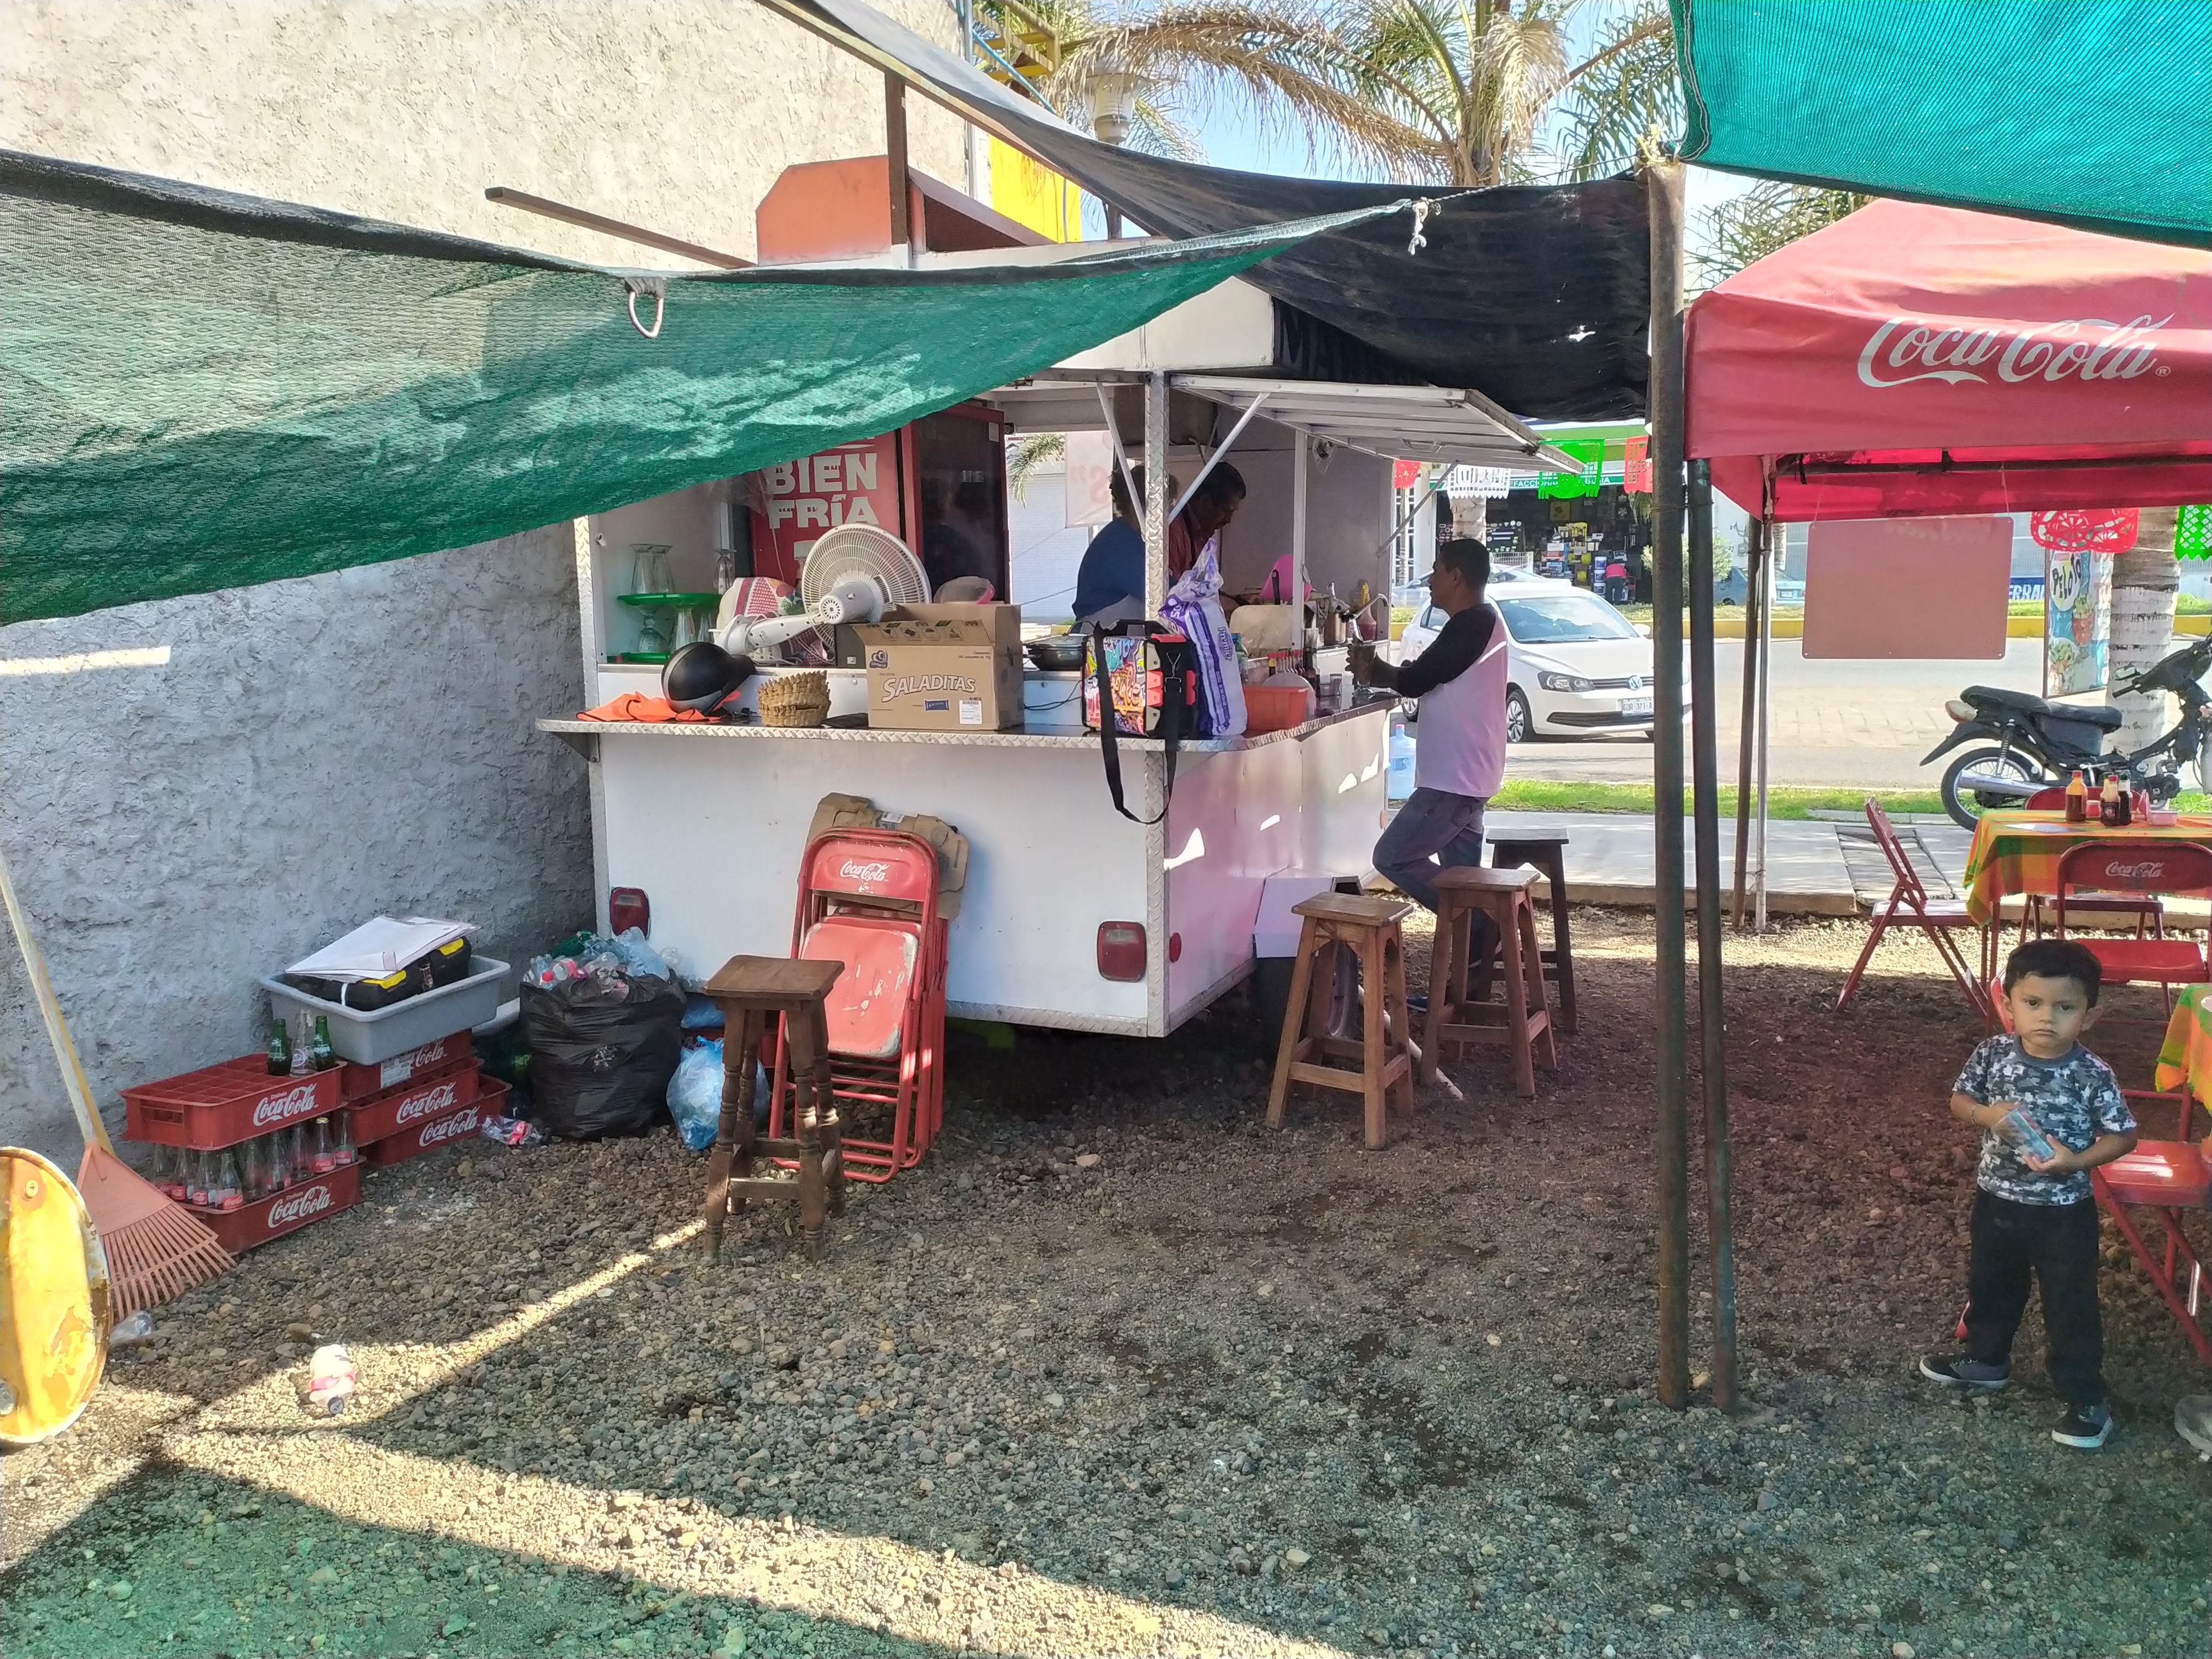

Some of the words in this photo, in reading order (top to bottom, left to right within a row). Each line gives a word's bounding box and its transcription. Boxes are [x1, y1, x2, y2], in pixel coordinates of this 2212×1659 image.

[763, 453, 877, 495] BIEN
[769, 494, 880, 529] FRÍA
[1218, 627, 1233, 662] Premier
[881, 674, 976, 703] SALADITAS
[840, 860, 890, 881] Coca-Cola
[253, 1083, 317, 1126] Coca-Cola
[396, 1081, 456, 1124] Coca-Cola
[419, 1105, 481, 1147] Coca-Cola
[268, 1182, 332, 1228] Coca-Cola
